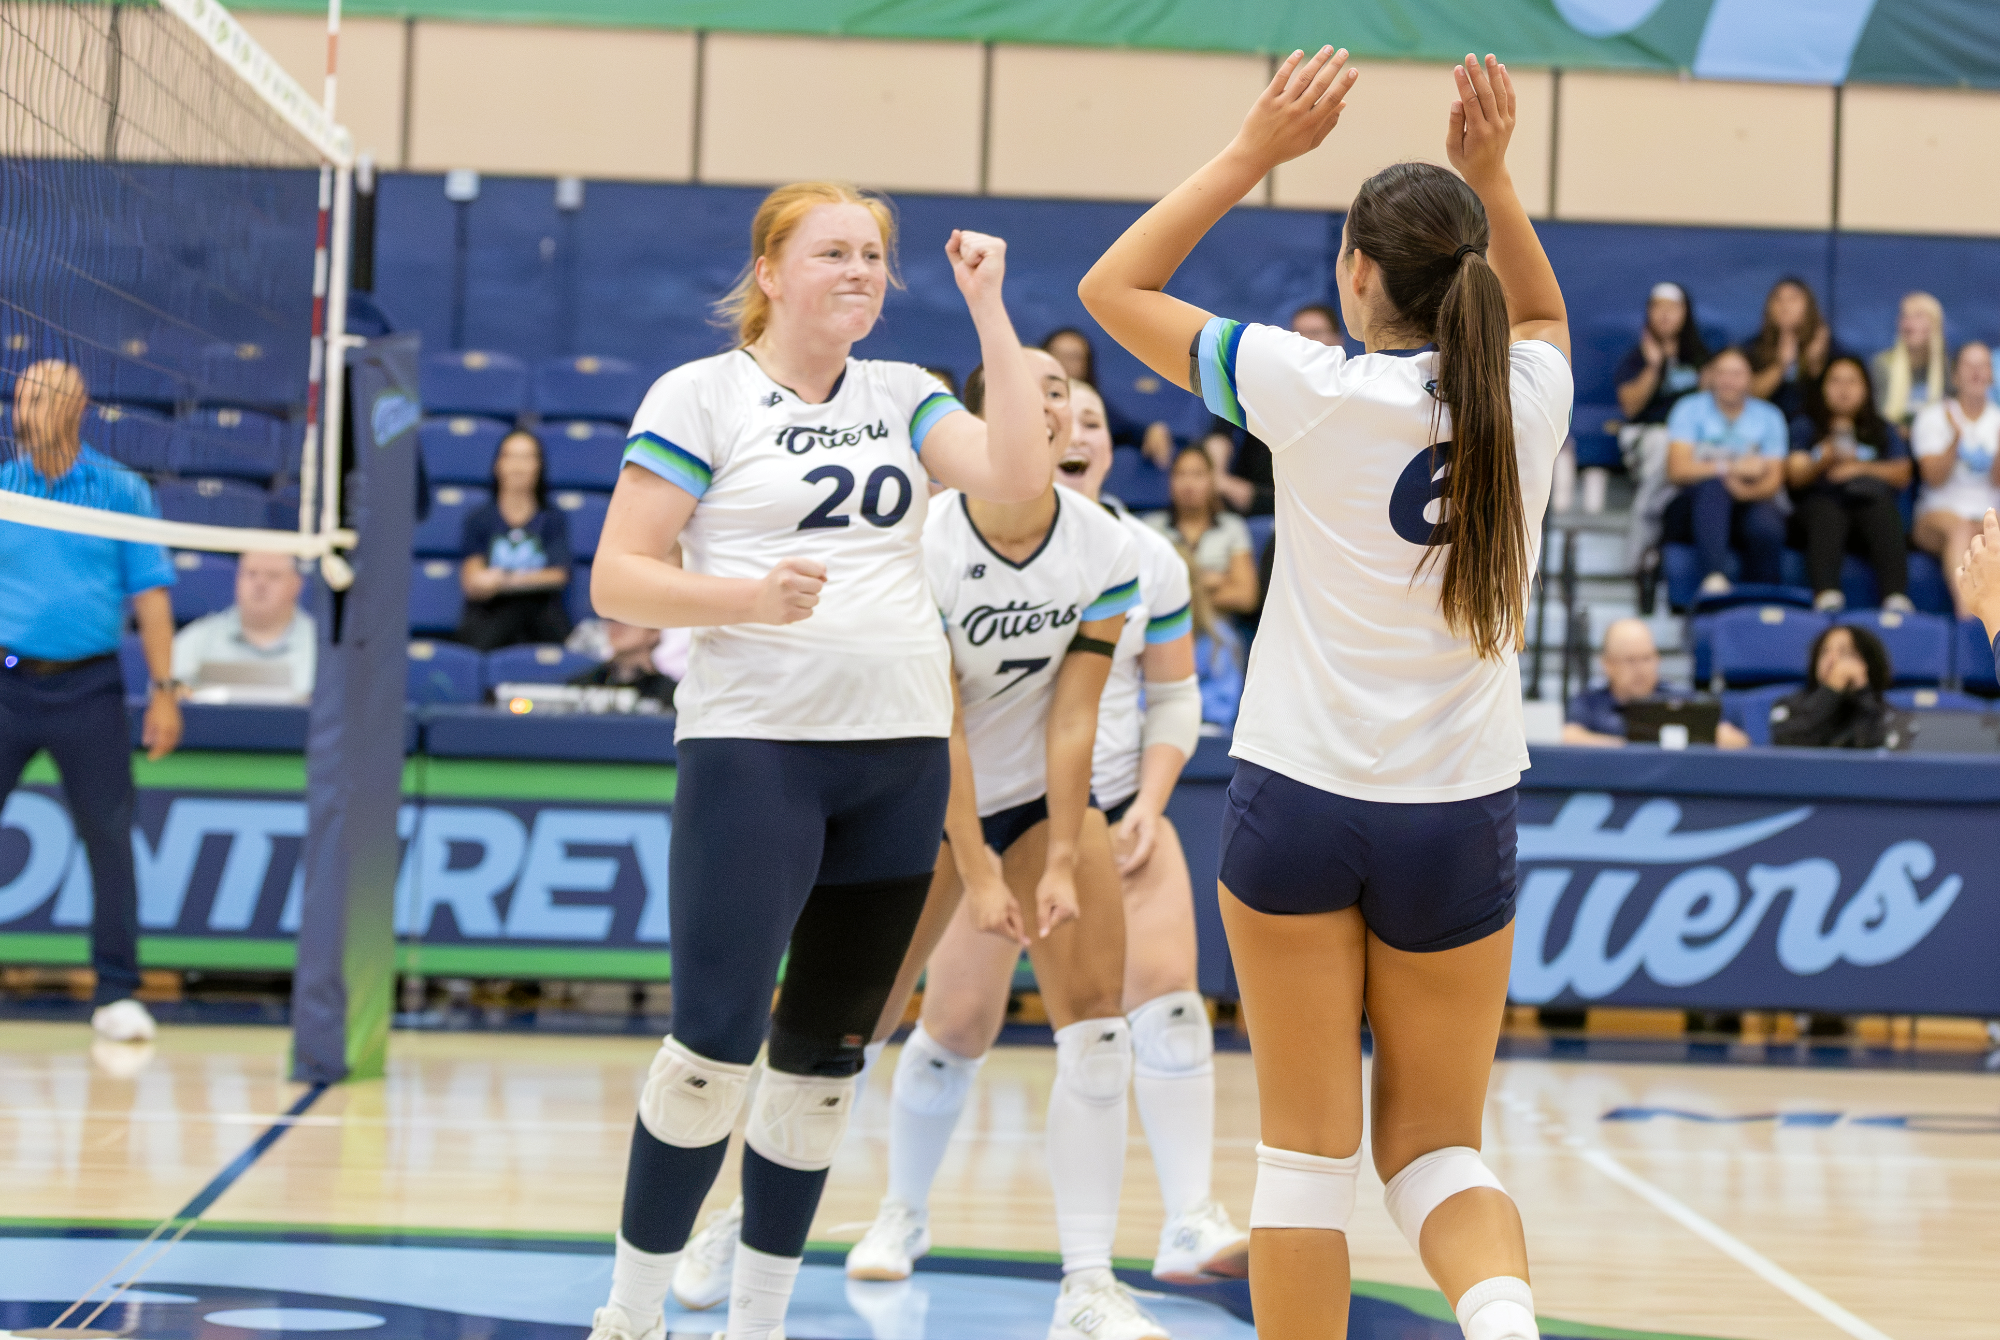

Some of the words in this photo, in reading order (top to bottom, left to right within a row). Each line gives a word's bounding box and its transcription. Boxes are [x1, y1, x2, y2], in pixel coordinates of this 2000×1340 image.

[775, 419, 888, 455] Otters
[797, 464, 912, 531] 20
[961, 600, 1079, 646] Otters
[987, 657, 1051, 700] 7
[1509, 793, 1963, 1003] tters
